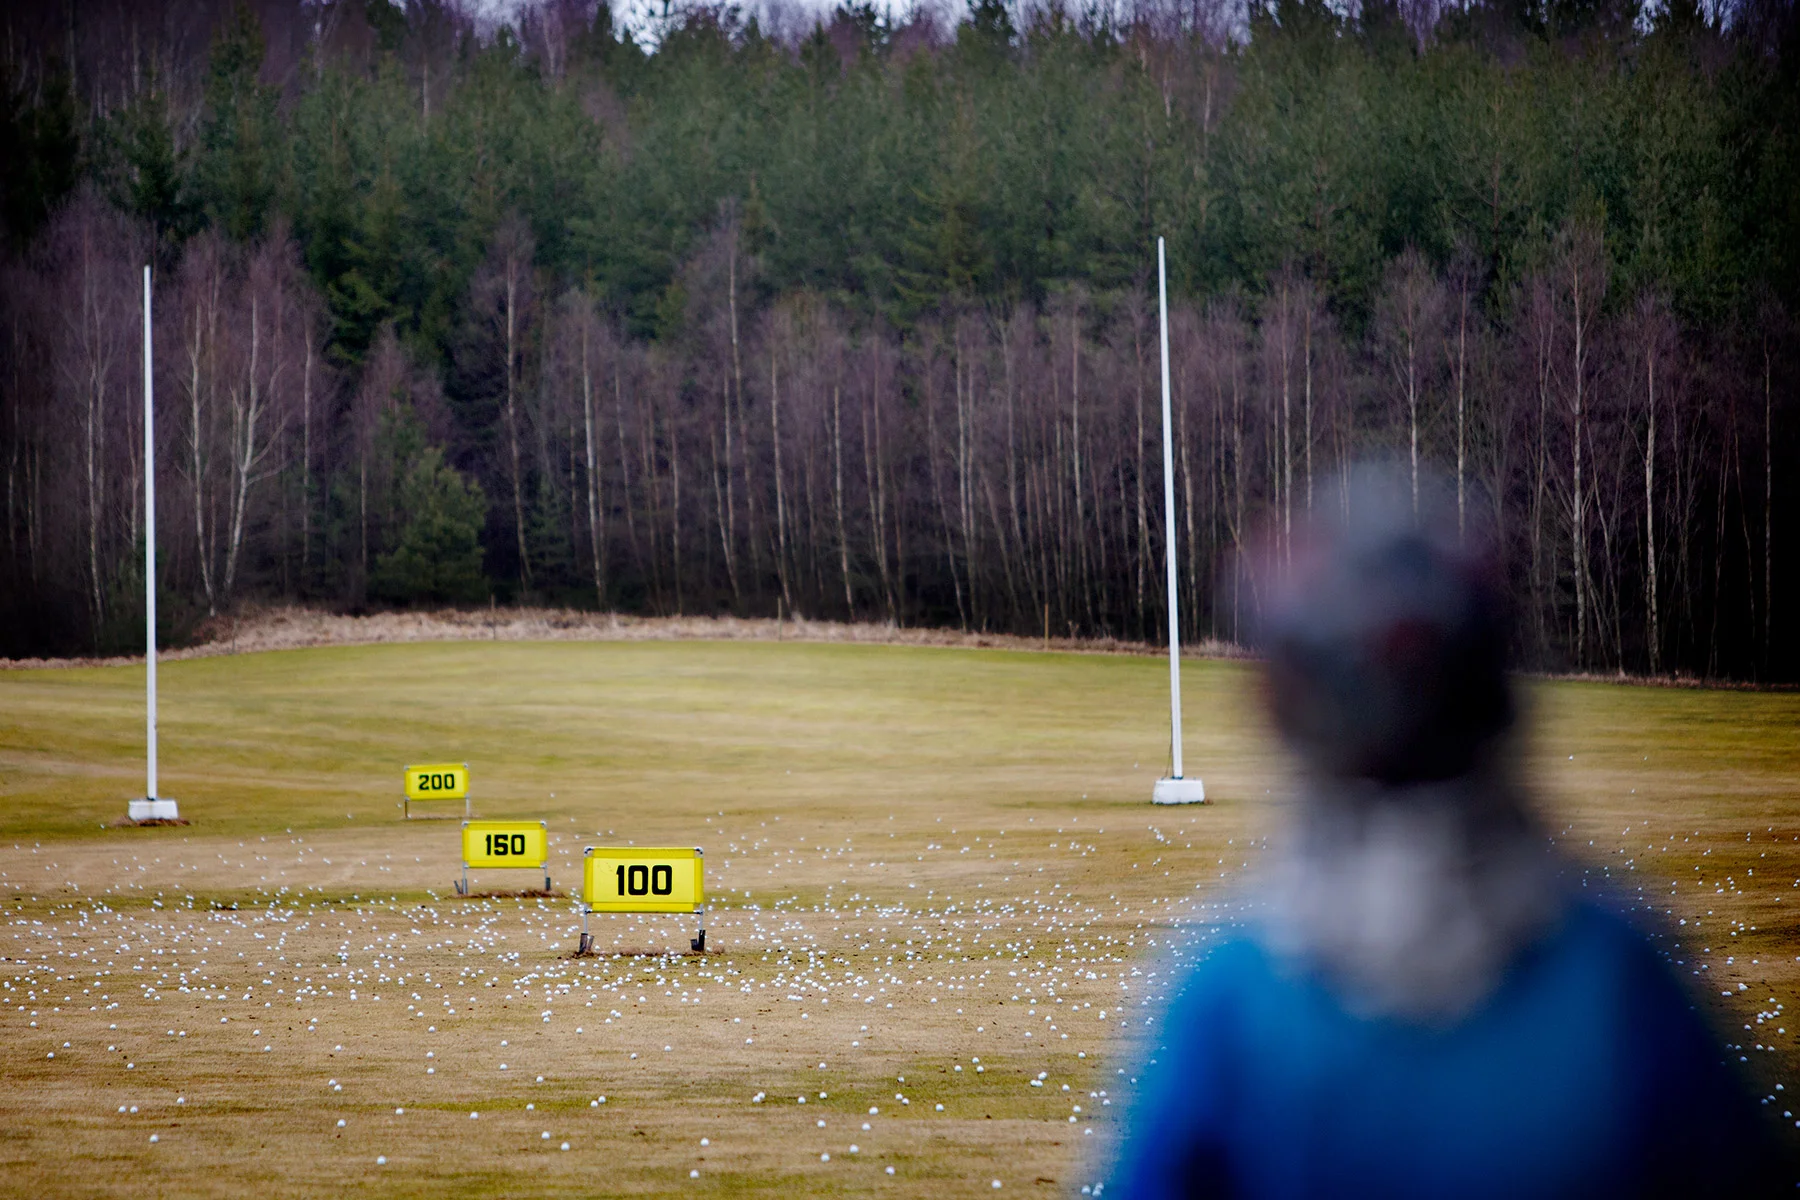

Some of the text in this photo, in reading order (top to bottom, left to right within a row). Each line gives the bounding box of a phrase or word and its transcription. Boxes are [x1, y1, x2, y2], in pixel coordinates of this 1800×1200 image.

[418, 773, 455, 791] 200
[485, 834, 526, 856] 150
[615, 864, 673, 896] 100
